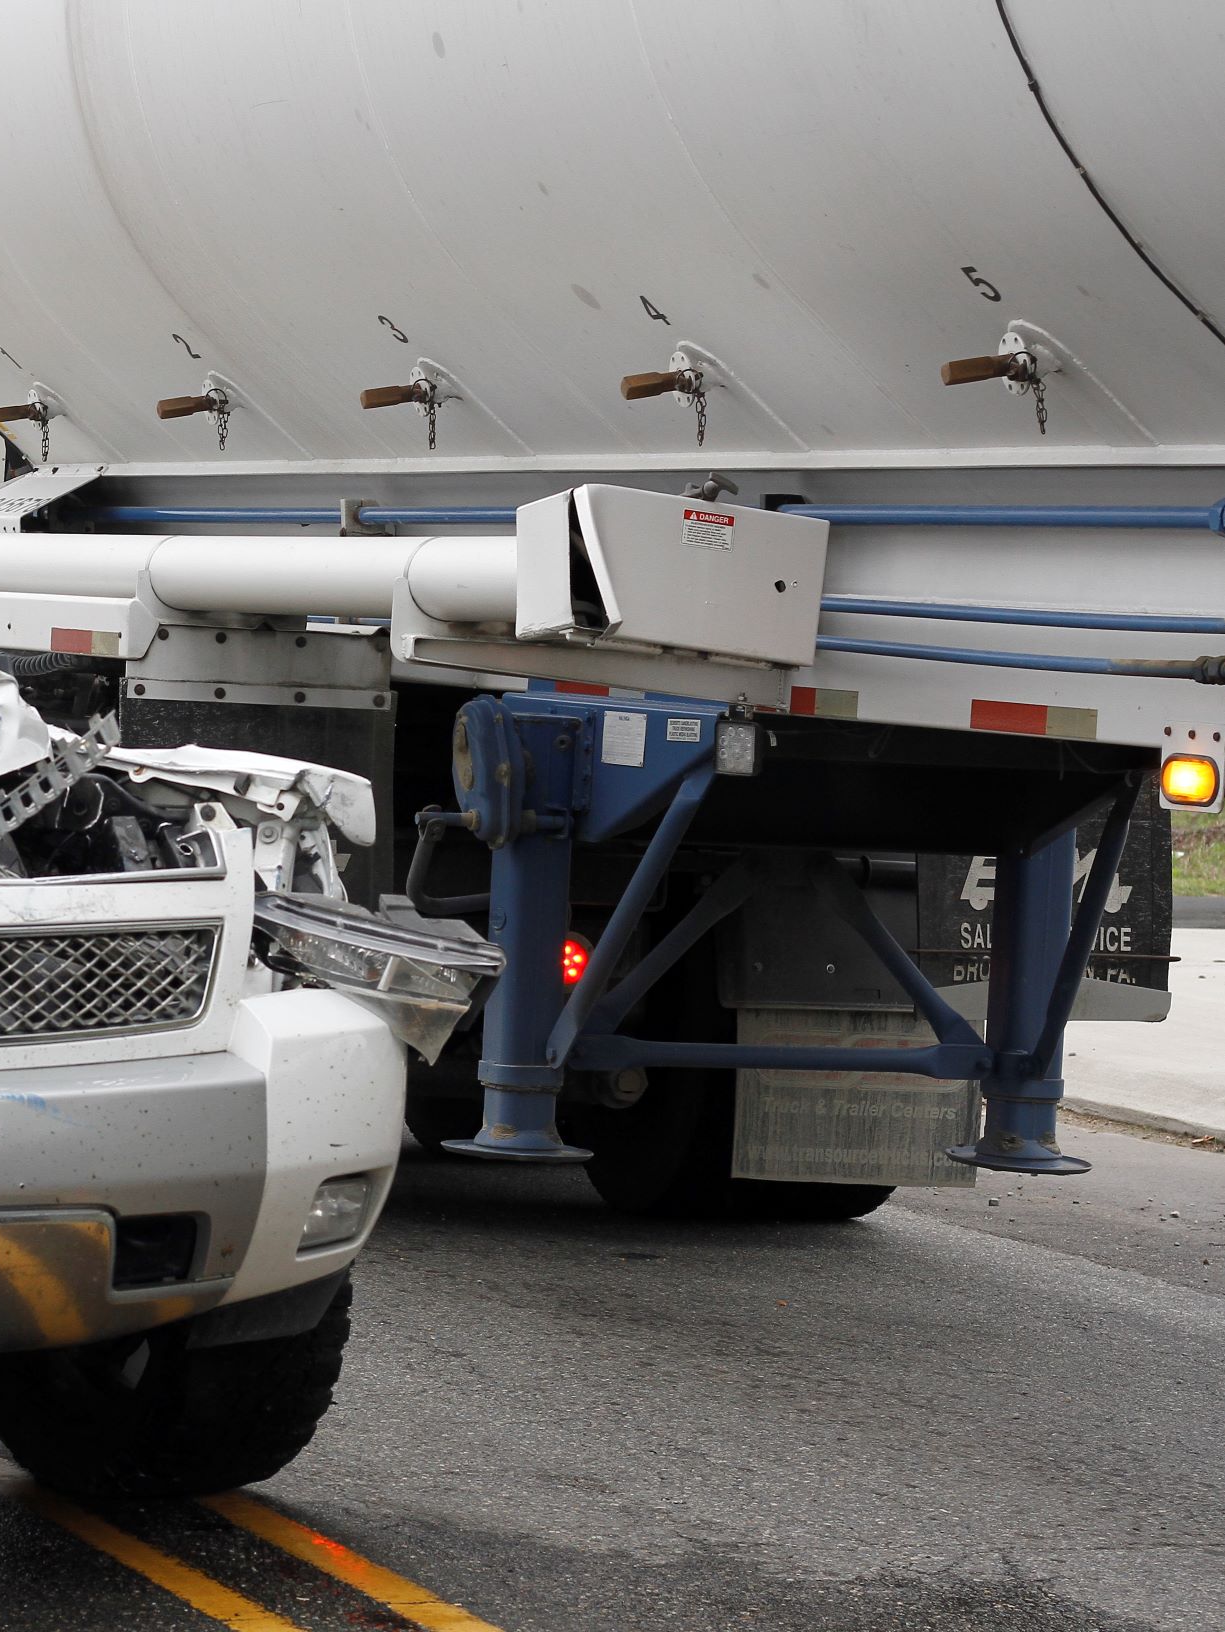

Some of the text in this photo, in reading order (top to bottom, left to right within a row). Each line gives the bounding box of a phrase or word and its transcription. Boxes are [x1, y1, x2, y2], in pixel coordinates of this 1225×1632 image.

[960, 266, 1001, 302] 5
[640, 295, 671, 326] 4
[377, 315, 409, 344] 3
[0, 346, 22, 369] 1
[172, 333, 202, 359] 2
[699, 513, 729, 524] DANGER
[960, 922, 992, 949] SAL
[834, 1100, 888, 1117] Trailer
[891, 1102, 957, 1120] Centers
